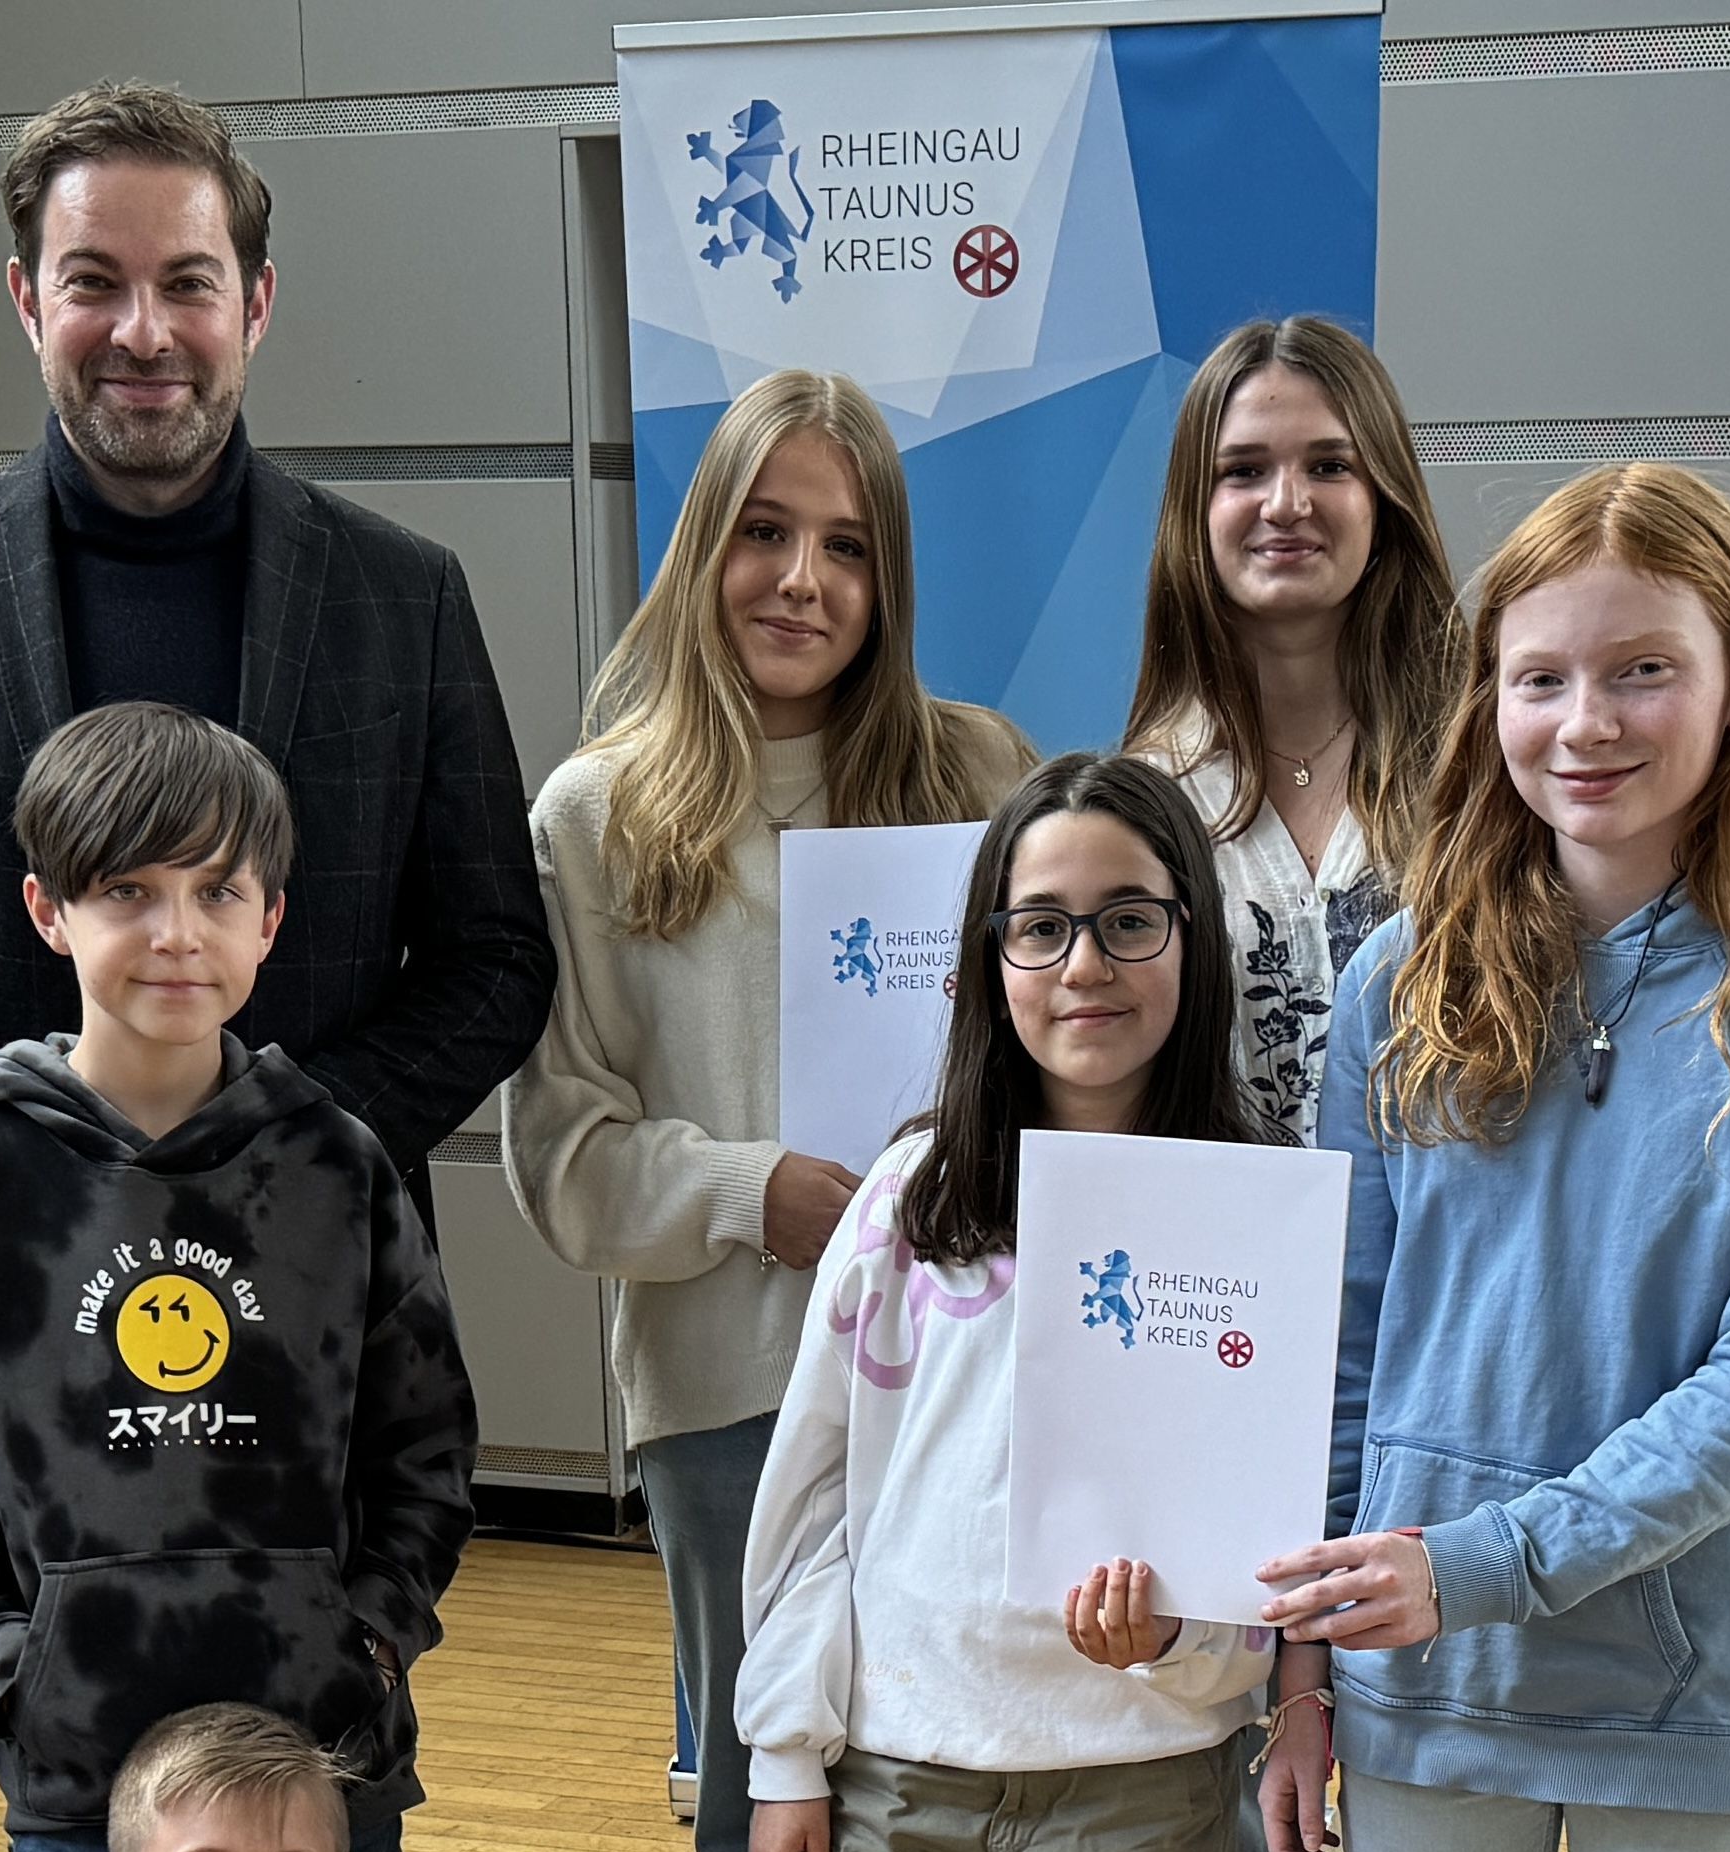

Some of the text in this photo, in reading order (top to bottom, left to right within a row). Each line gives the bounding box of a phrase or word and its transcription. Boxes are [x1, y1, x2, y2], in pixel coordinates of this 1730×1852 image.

[822, 126, 1020, 169] RHEINGAU
[818, 181, 975, 221] TAUNUS
[824, 236, 933, 273] KREIS
[886, 951, 955, 969] TAUNUS
[886, 974, 936, 990] KREIS
[74, 1237, 265, 1335] make it a good day
[1148, 1271, 1259, 1299] RHEINGAU
[1146, 1297, 1234, 1324] TAUNUS
[1146, 1325, 1209, 1349] KREIS
[108, 1402, 257, 1440] スマイリー
